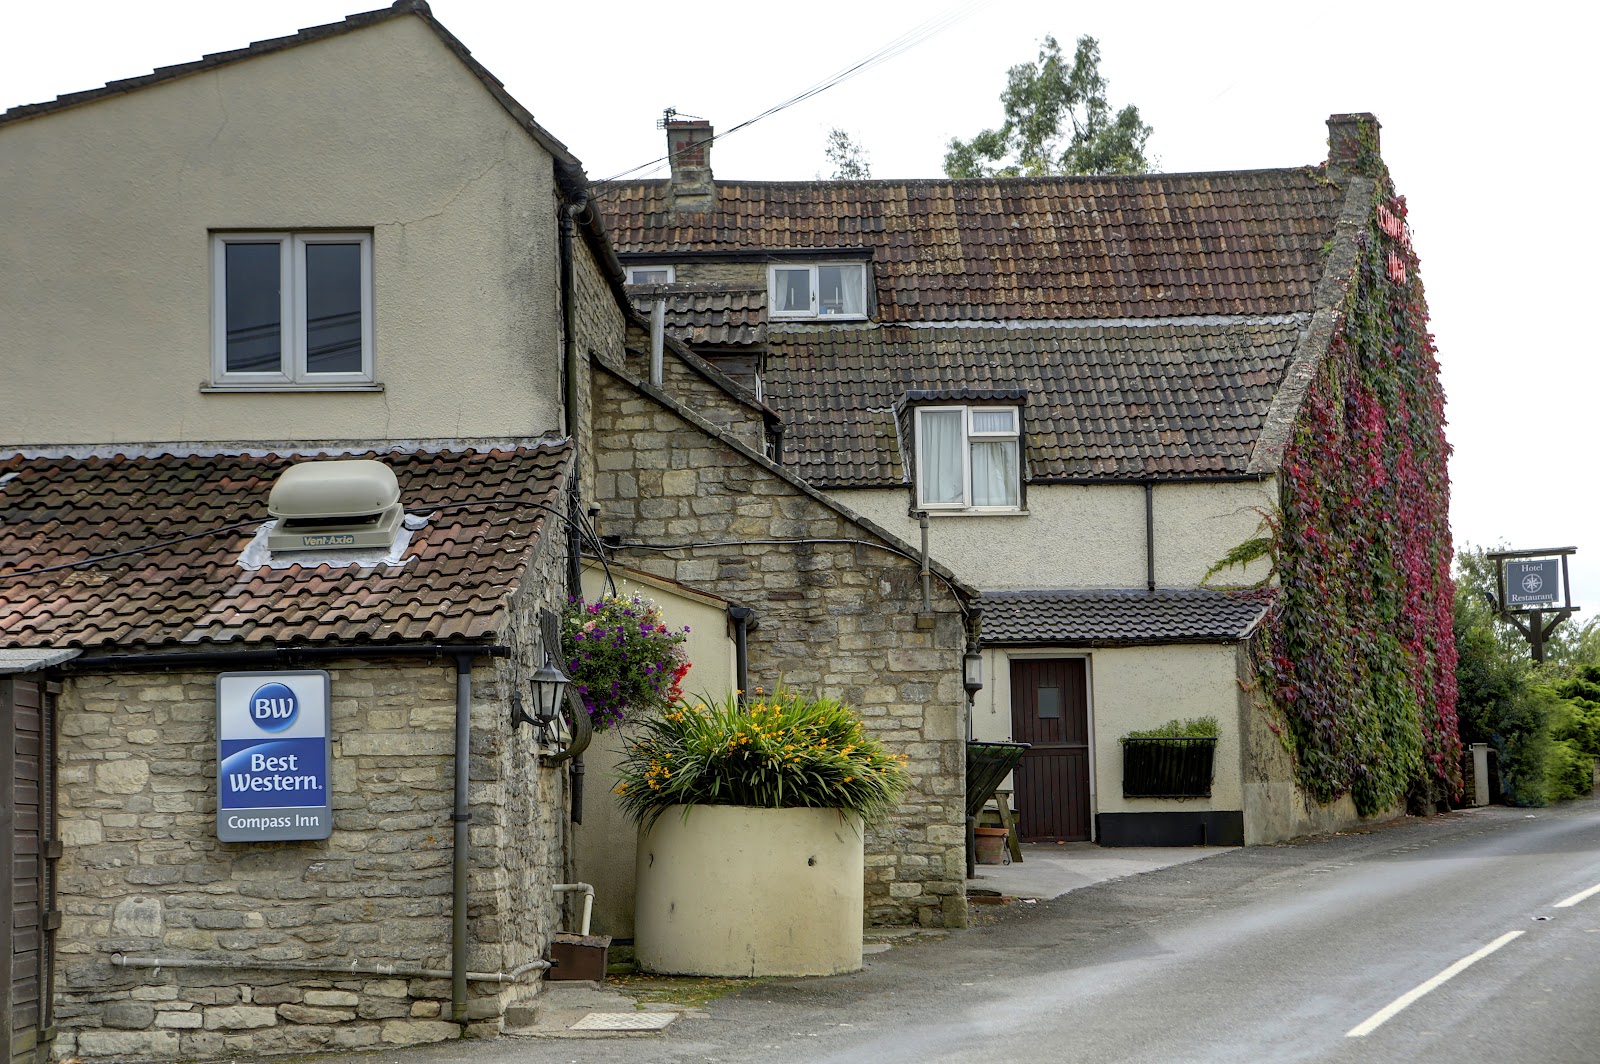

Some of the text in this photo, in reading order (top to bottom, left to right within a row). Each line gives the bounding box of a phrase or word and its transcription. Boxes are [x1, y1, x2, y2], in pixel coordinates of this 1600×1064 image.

[303, 535, 354, 546] Vent-Axia
[1521, 563, 1543, 572] Hotel
[1511, 593, 1554, 602] Restaurant
[255, 698, 293, 719] BW
[251, 753, 298, 772] Best
[227, 814, 320, 831] Compass Inn
